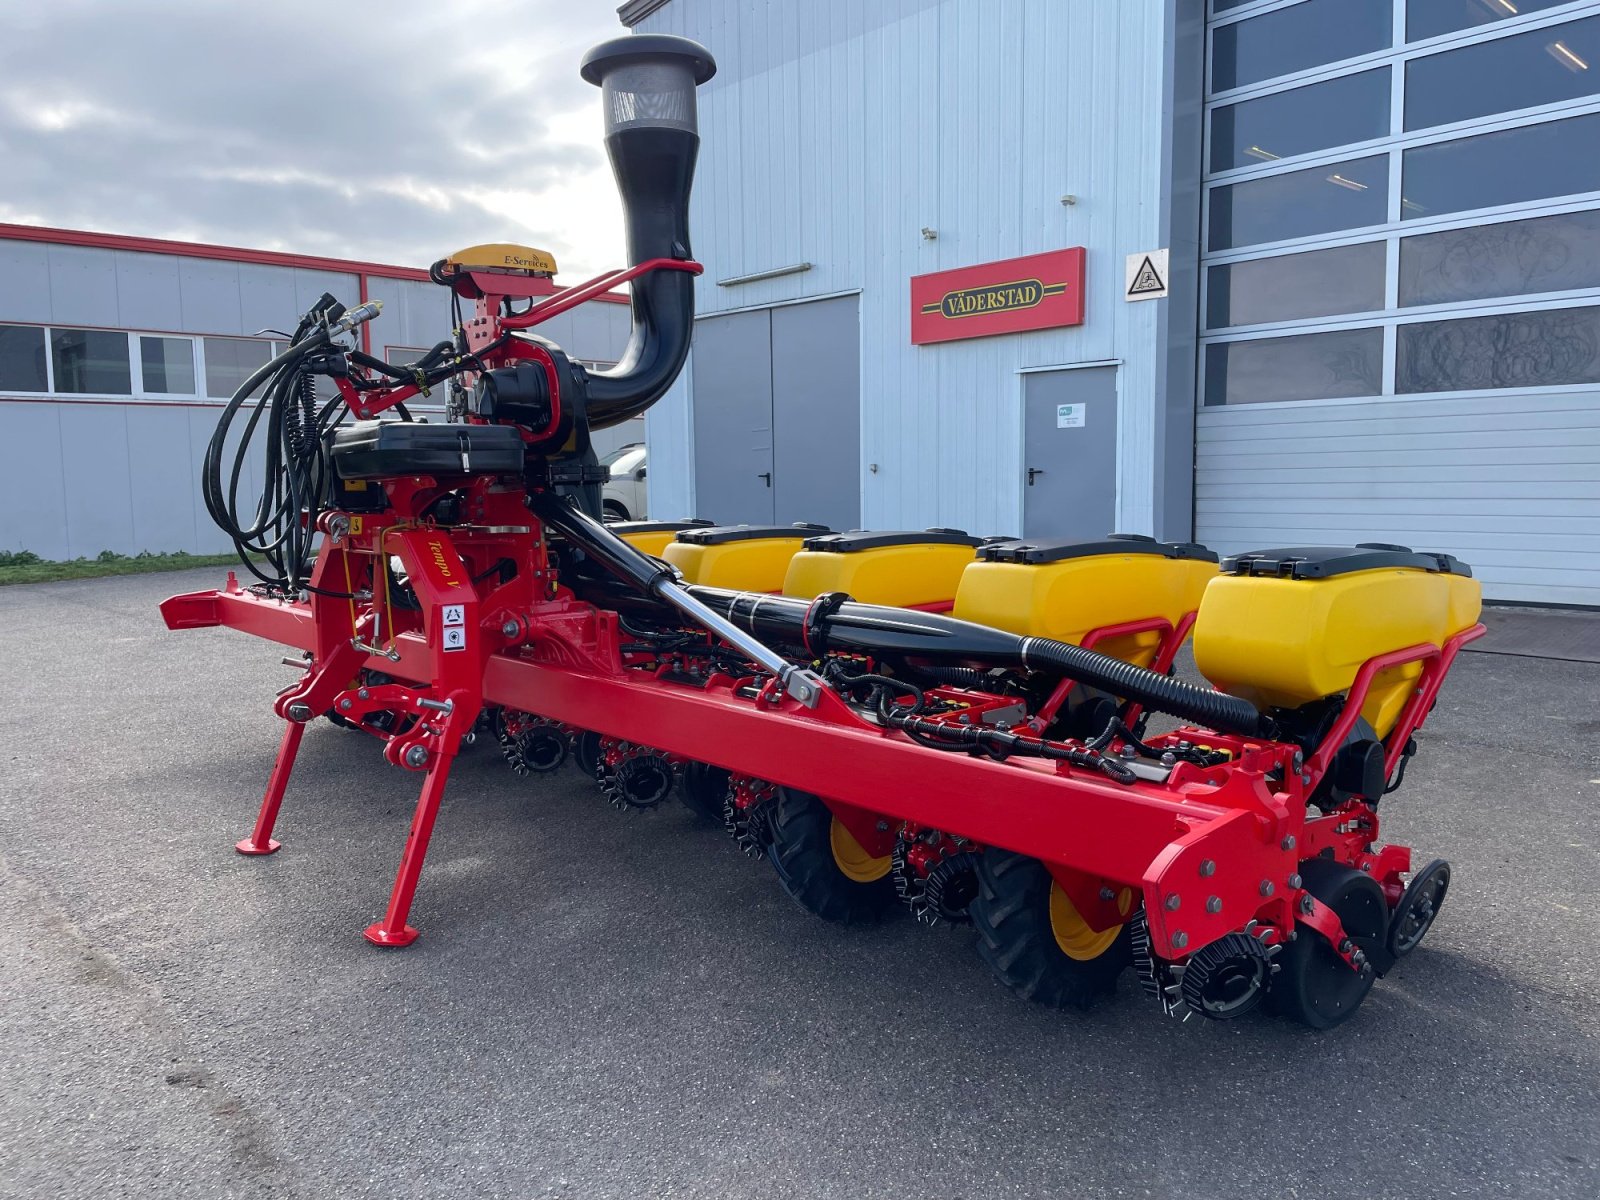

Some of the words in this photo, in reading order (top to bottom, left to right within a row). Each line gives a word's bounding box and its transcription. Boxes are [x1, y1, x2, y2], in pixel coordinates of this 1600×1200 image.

[504, 255, 549, 269] E-Services
[947, 285, 1037, 315] VÄDERSTAD
[428, 540, 452, 577] Tempo
[446, 580, 462, 590] V
